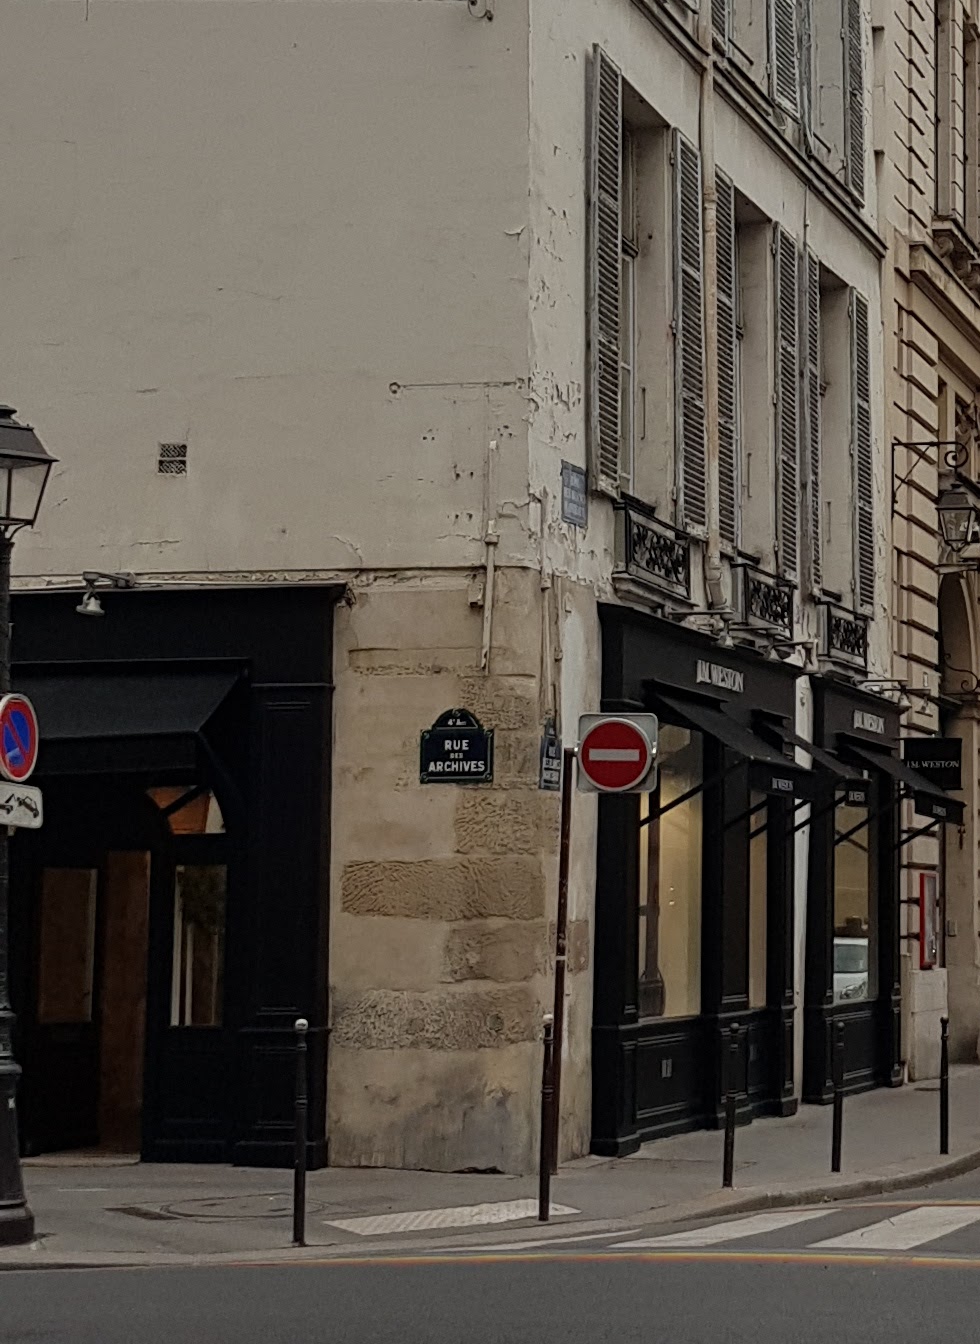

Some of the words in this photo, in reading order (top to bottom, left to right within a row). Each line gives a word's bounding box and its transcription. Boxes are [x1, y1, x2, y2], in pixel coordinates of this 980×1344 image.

[710, 663, 744, 693] WESTON
[444, 739, 470, 751] RUE
[428, 760, 485, 772] ARCHIVES
[921, 760, 960, 769] WESTON
